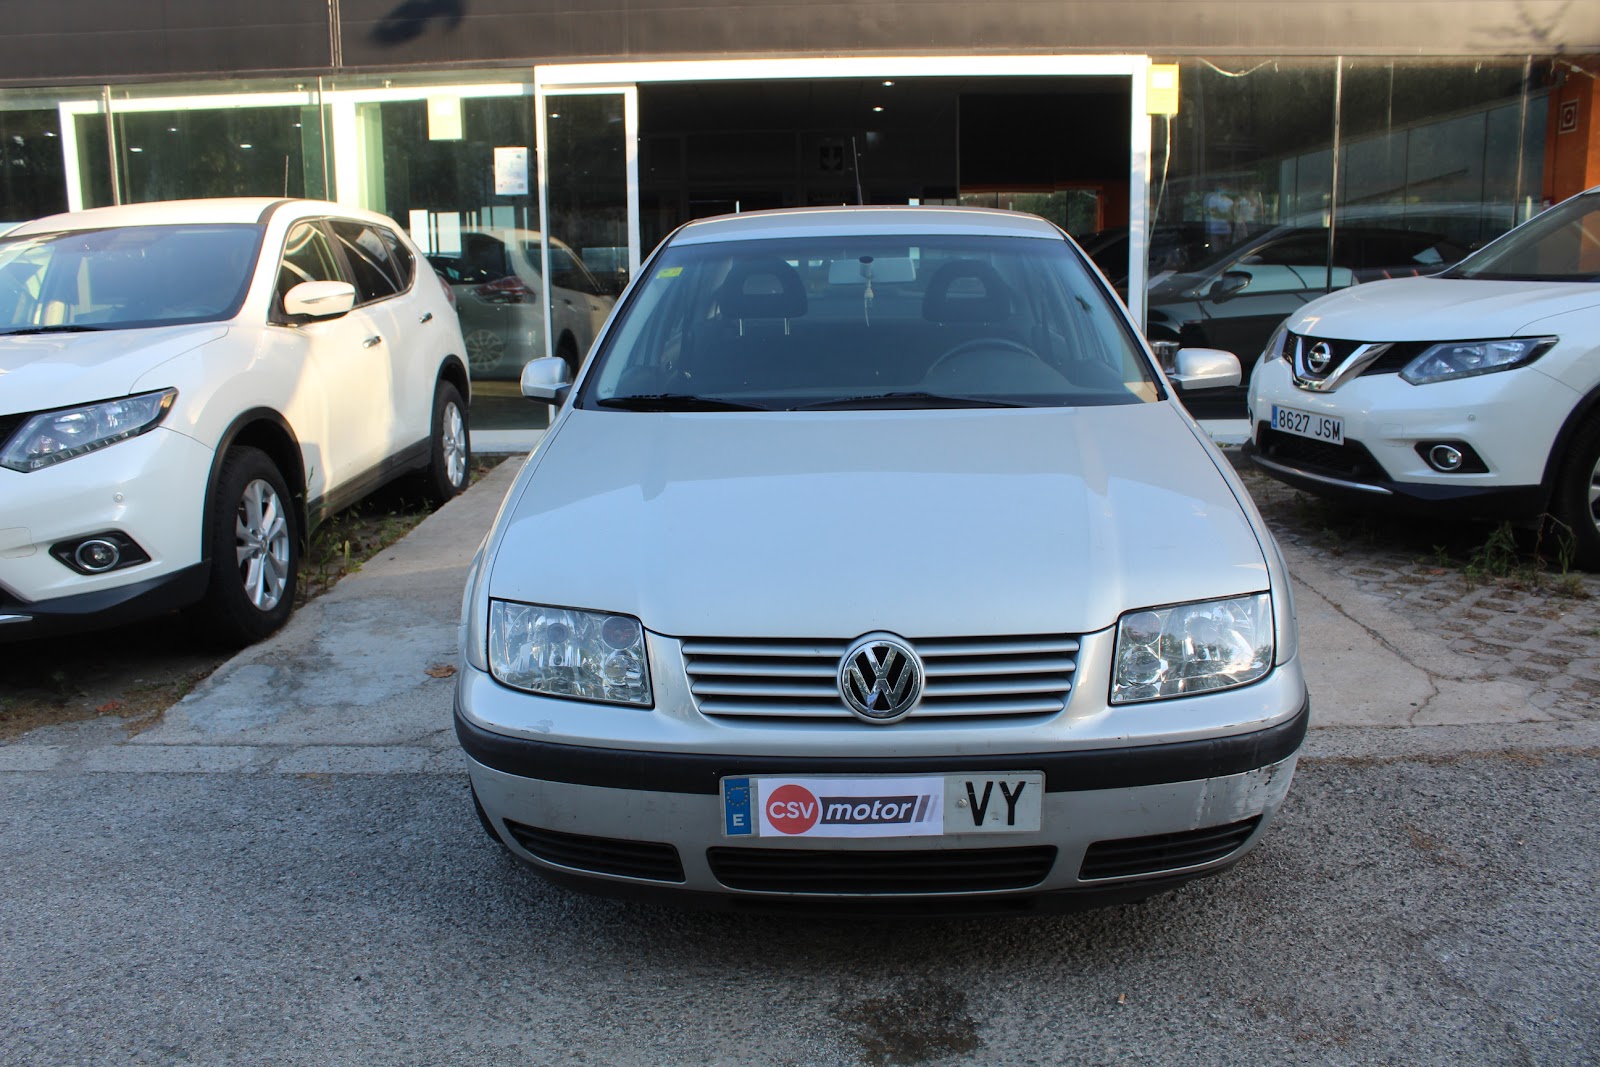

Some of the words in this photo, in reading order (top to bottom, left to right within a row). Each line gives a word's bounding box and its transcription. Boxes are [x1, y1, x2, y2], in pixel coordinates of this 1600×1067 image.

[1279, 410, 1310, 433] 8627
[1315, 418, 1340, 441] JSM
[769, 801, 815, 819] CSV
[825, 800, 912, 821] motor
[965, 781, 1027, 826] VY
[733, 814, 745, 827] E
